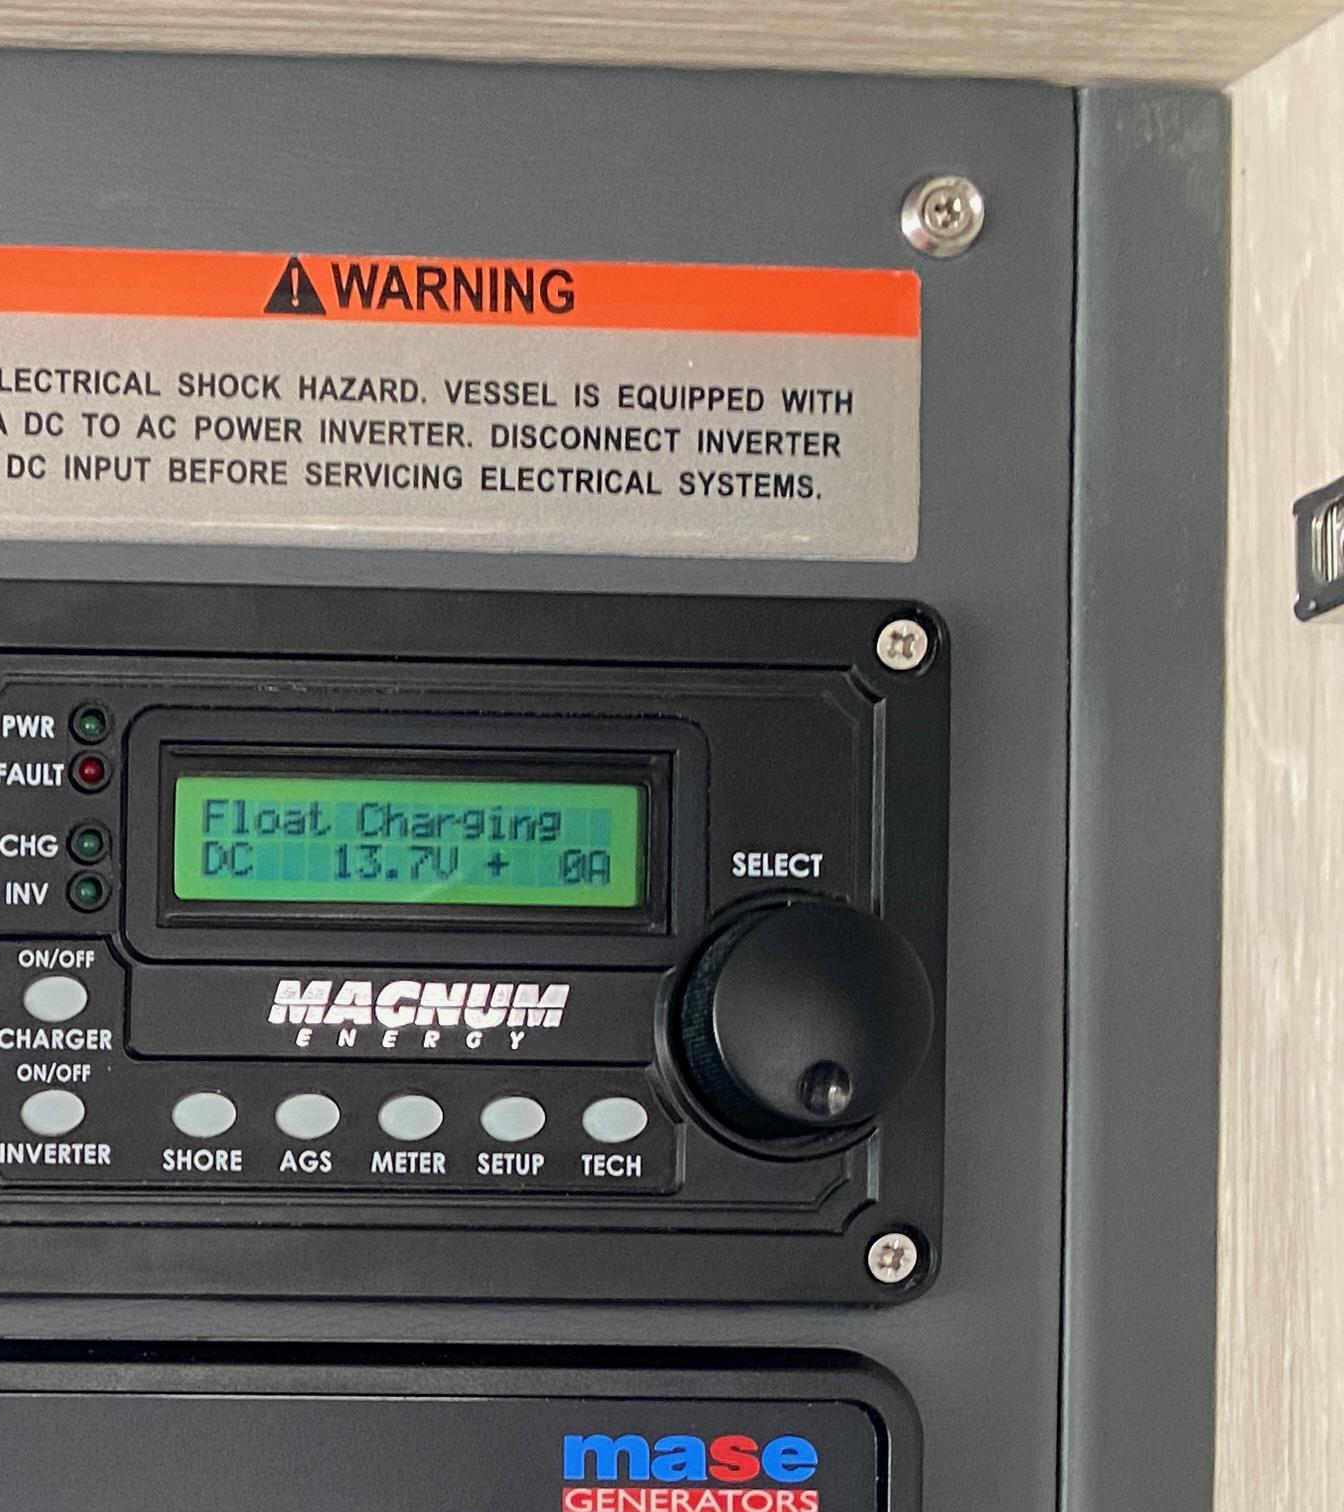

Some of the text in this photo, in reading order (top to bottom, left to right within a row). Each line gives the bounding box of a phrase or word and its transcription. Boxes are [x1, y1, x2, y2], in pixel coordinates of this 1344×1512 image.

[331, 262, 575, 315] WARNING
[177, 371, 282, 400] SHOCK
[299, 375, 427, 404] HAZARD.
[444, 379, 558, 407] VESSEL
[574, 383, 600, 409] IS
[618, 384, 765, 413] EQUIPPED
[781, 388, 853, 415] WITH
[24, 411, 64, 437] DC
[81, 412, 121, 439] TO
[136, 414, 177, 440] AC
[194, 415, 303, 444] POWER
[320, 418, 473, 449] INVERTER.
[491, 423, 681, 453] DISCONNECT
[697, 429, 841, 458] INVERTER
[6, 453, 822, 500] DC INPUT BEFORE SERVICING ELECTRICAL SYSTEMS.
[2, 714, 55, 739] PWR
[201, 798, 563, 841] Float Charging
[201, 840, 254, 878] DC
[732, 851, 824, 878] SELECT
[5, 881, 49, 905] INV
[18, 948, 95, 969] ON/OFF
[267, 980, 570, 1030] MAGNUM
[295, 1027, 525, 1050] ENERGY
[16, 1062, 91, 1084] ON/OFF
[0, 1142, 111, 1165] INVERTER
[162, 1148, 242, 1172] SHORE
[279, 1150, 332, 1173] AGS
[371, 1150, 446, 1175] METER
[477, 1152, 545, 1176] SETUP
[581, 1154, 642, 1177] TECH
[563, 1434, 818, 1483] mase
